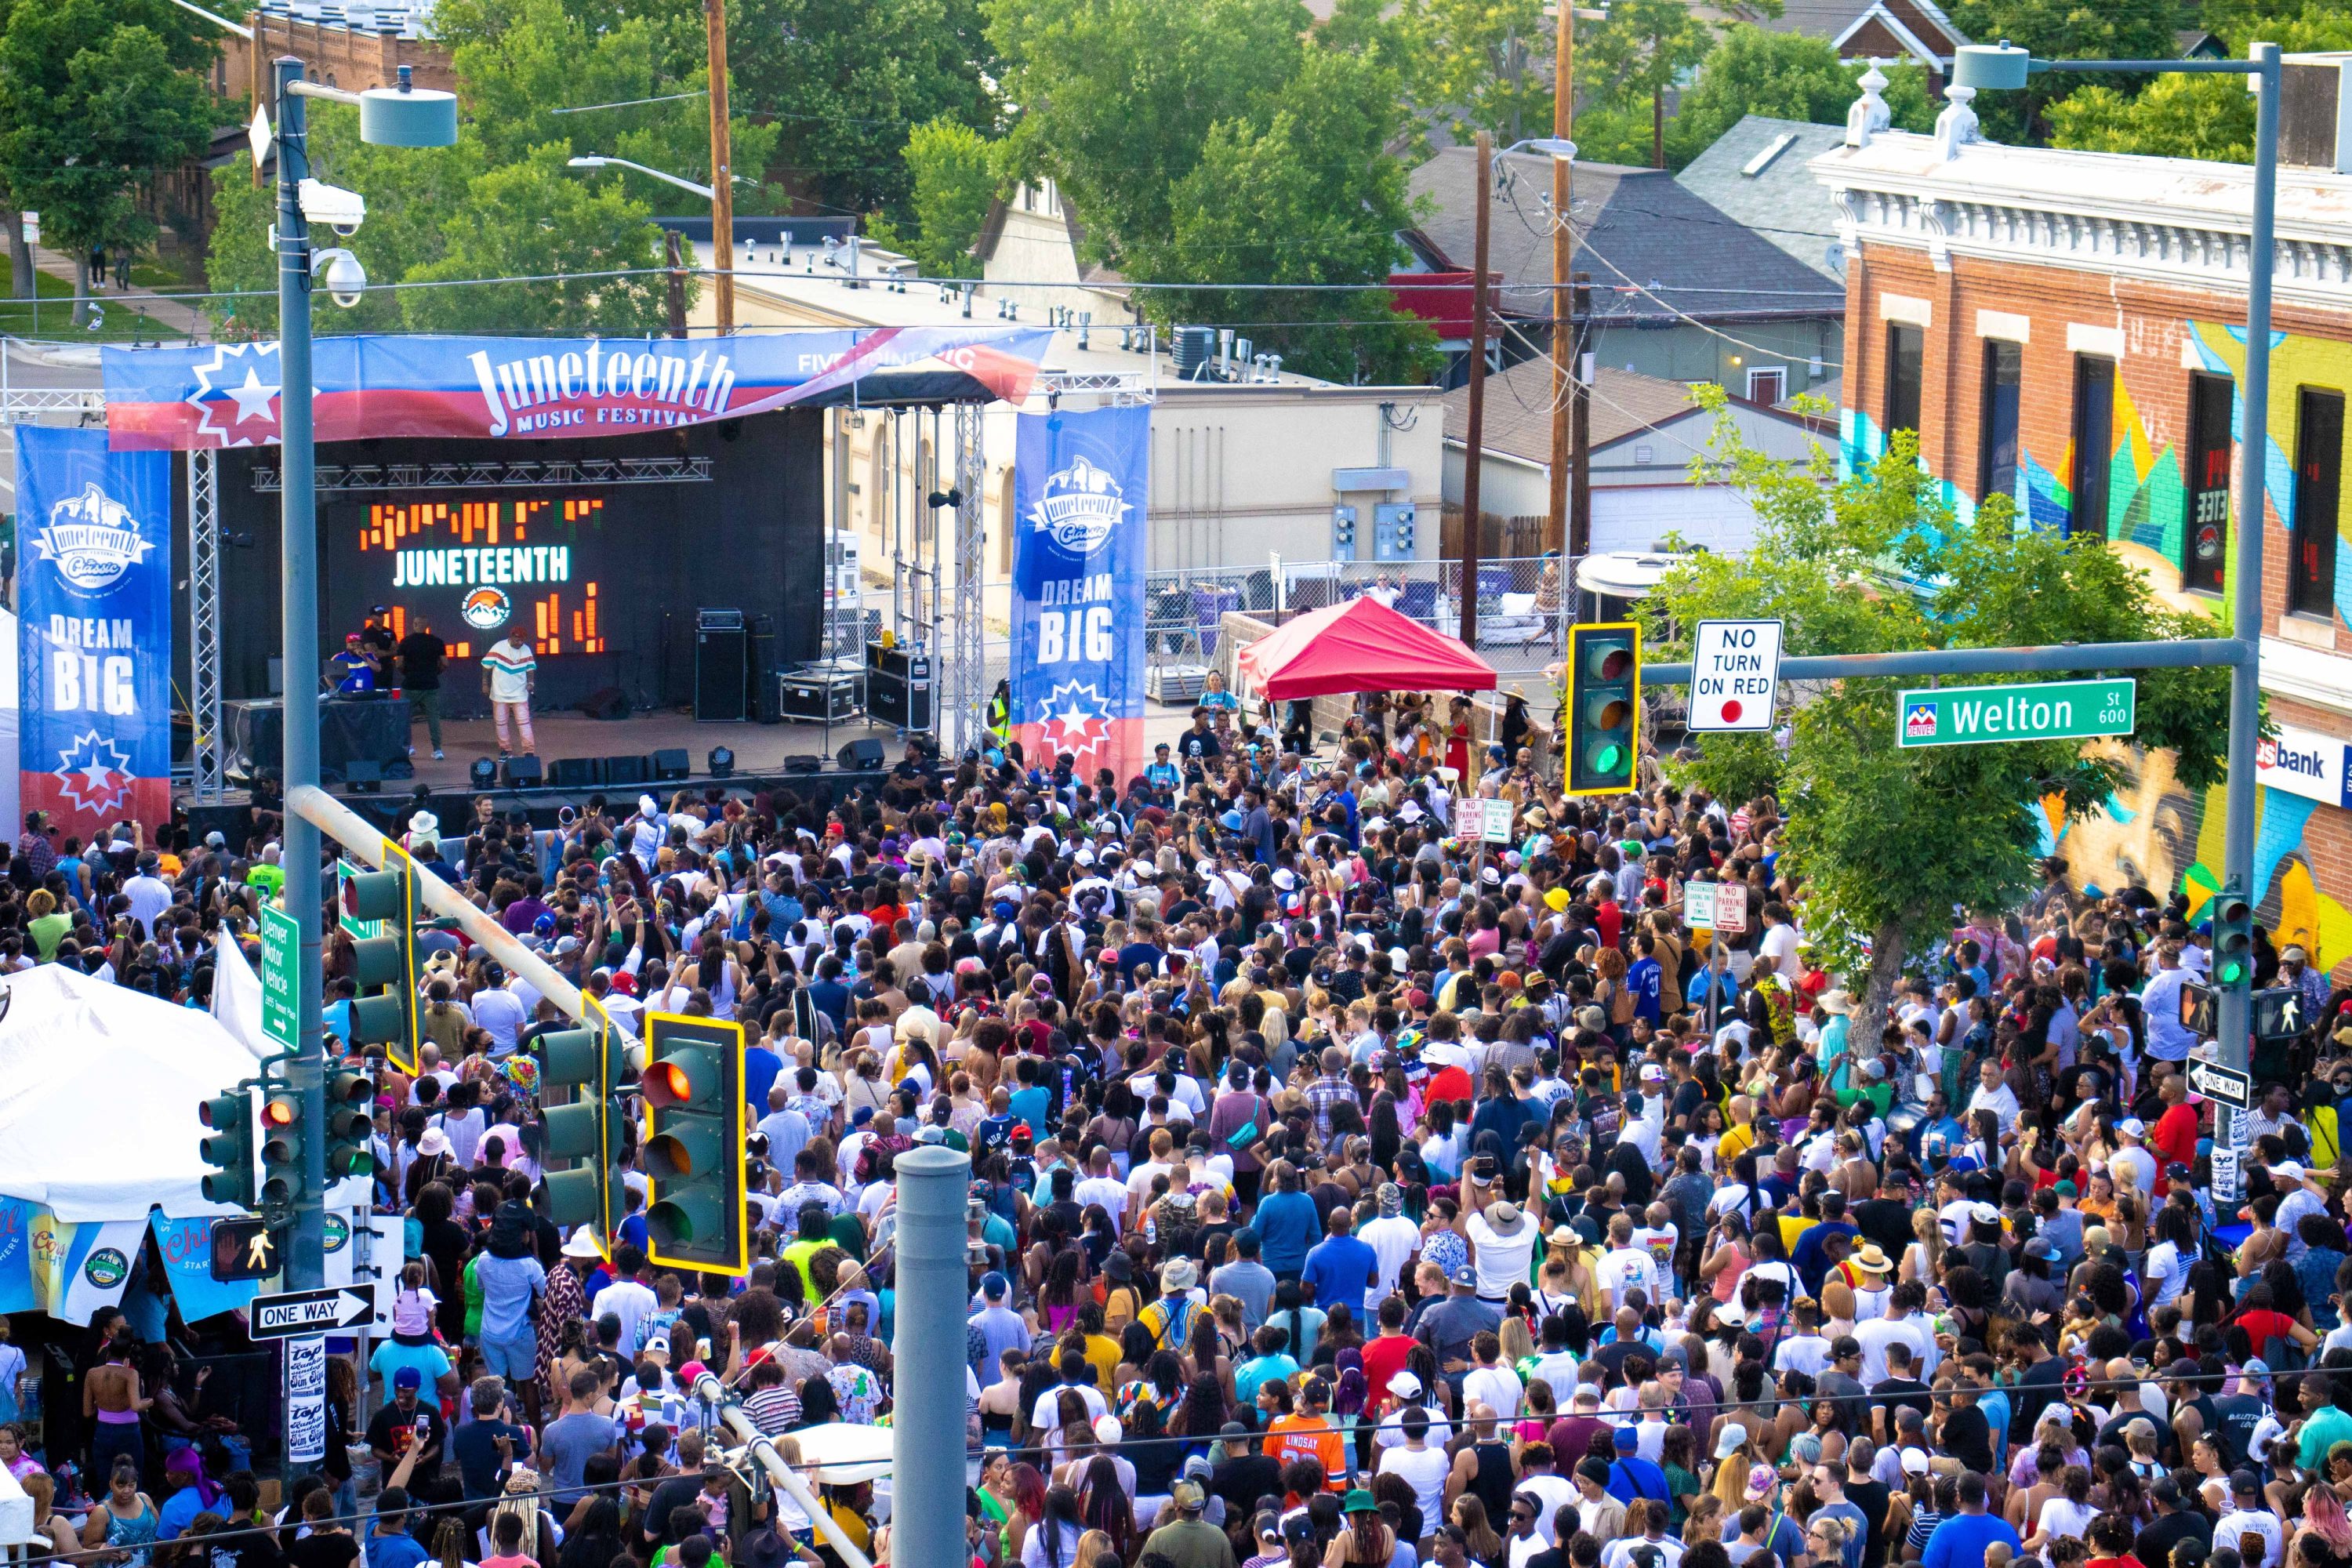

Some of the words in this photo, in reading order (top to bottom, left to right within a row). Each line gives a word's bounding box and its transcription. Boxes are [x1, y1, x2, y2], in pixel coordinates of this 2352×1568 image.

[466, 339, 735, 437] Juneteenth
[516, 408, 584, 432] MUSIC
[1042, 495, 1121, 529] Juneteenth
[47, 526, 136, 560] Juneteenth
[67, 556, 121, 579] Classic
[394, 546, 569, 586] JUNETEENTH
[476, 586, 505, 597] COLORADO
[1041, 573, 1112, 607] DREAM
[50, 614, 132, 649] DREAM
[461, 611, 481, 628] COLORADO
[1037, 606, 1112, 664] BIG
[1722, 629, 1756, 648] NO
[1714, 655, 1762, 671] TURN
[53, 652, 133, 716] BIG
[1699, 678, 1724, 695] ON
[1733, 678, 1769, 695] RED
[1952, 696, 2072, 734] Welton
[2107, 692, 2120, 706] St
[2099, 709, 2126, 724] 600
[1907, 724, 1936, 736] DENVER
[1459, 811, 1482, 819] PARKING
[1465, 801, 1475, 810] NO
[1719, 897, 1744, 908] PARKING
[1725, 887, 1737, 896] NO
[263, 914, 288, 945] Denver
[263, 938, 283, 967] Motor
[265, 964, 287, 996] Vehicle
[1649, 975, 1659, 998] 31
[2205, 1073, 2220, 1091] ONE
[2224, 1079, 2241, 1097] WAY
[264, 1306, 297, 1325] ONE
[304, 1301, 338, 1319] WAY
[1287, 1435, 1318, 1450] LINDSAY
